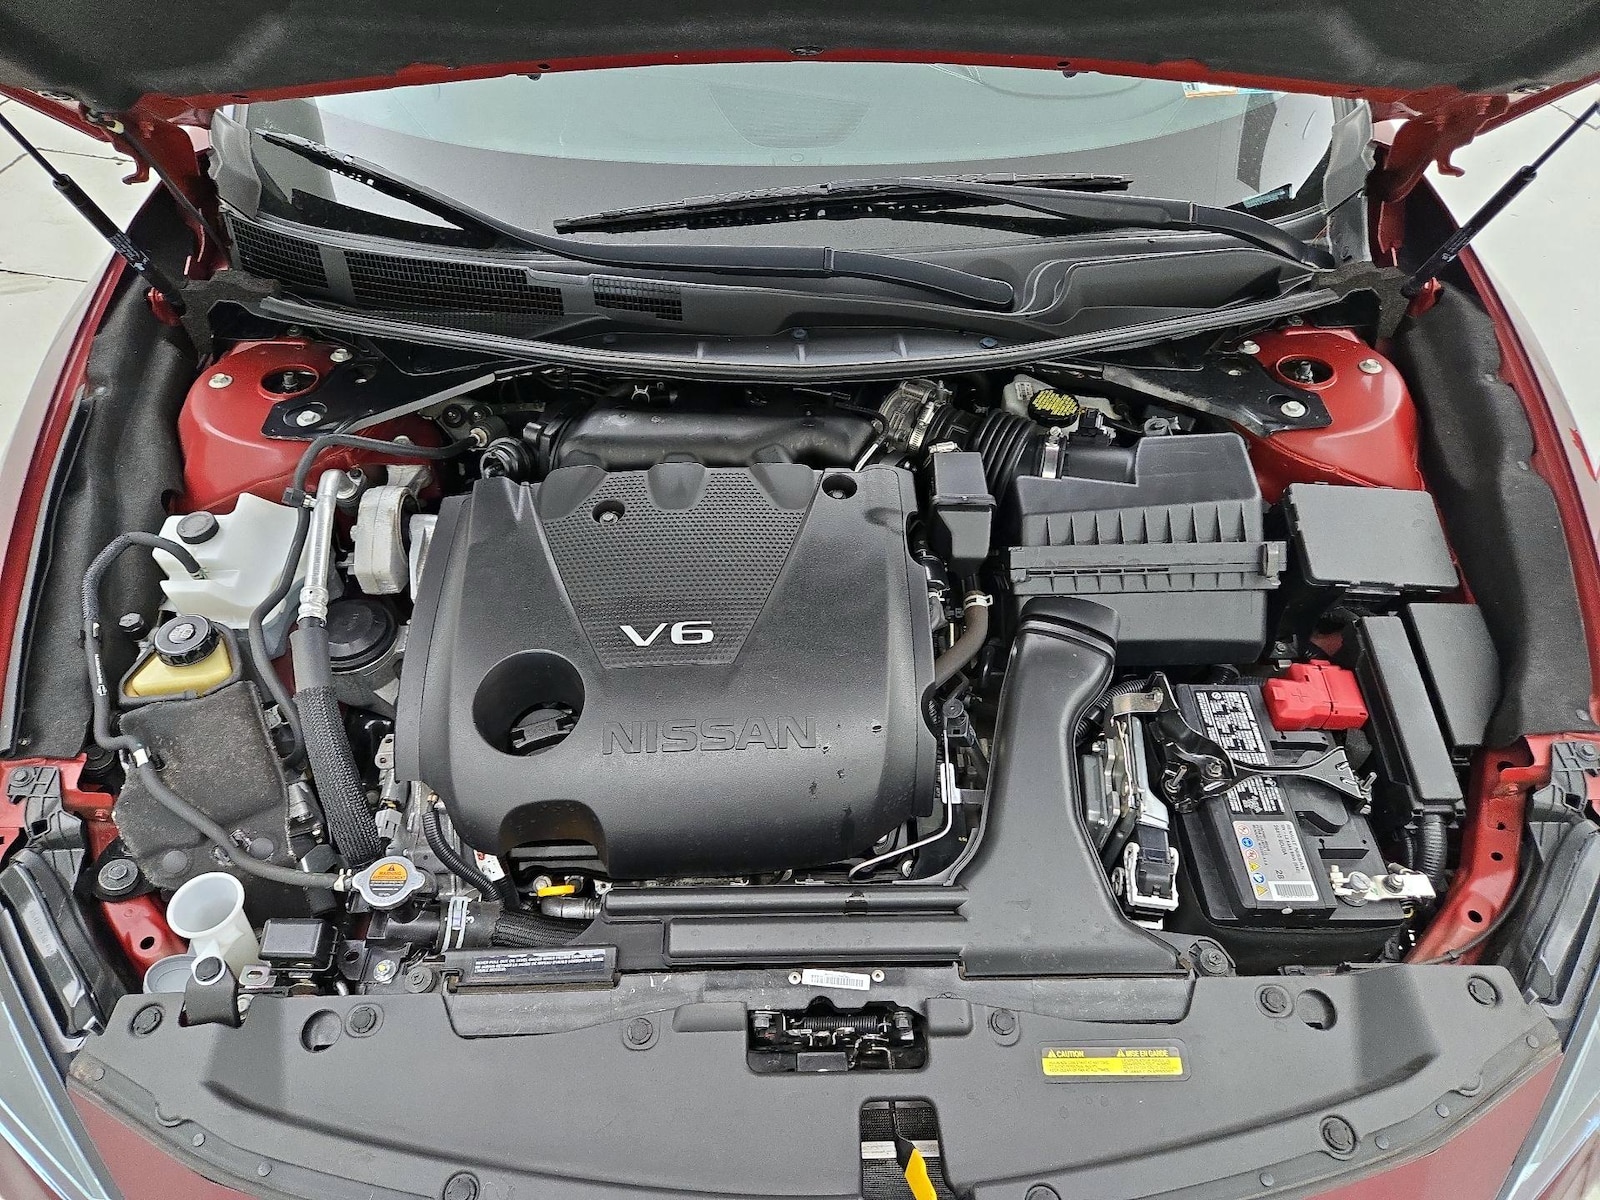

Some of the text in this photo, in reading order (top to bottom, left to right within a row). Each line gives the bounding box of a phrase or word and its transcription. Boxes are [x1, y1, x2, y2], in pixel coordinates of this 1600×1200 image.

[620, 621, 714, 647] V6
[603, 716, 816, 755] NISSAN
[1056, 1049, 1085, 1058] CAUTION
[1148, 1049, 1169, 1058] GARDE
